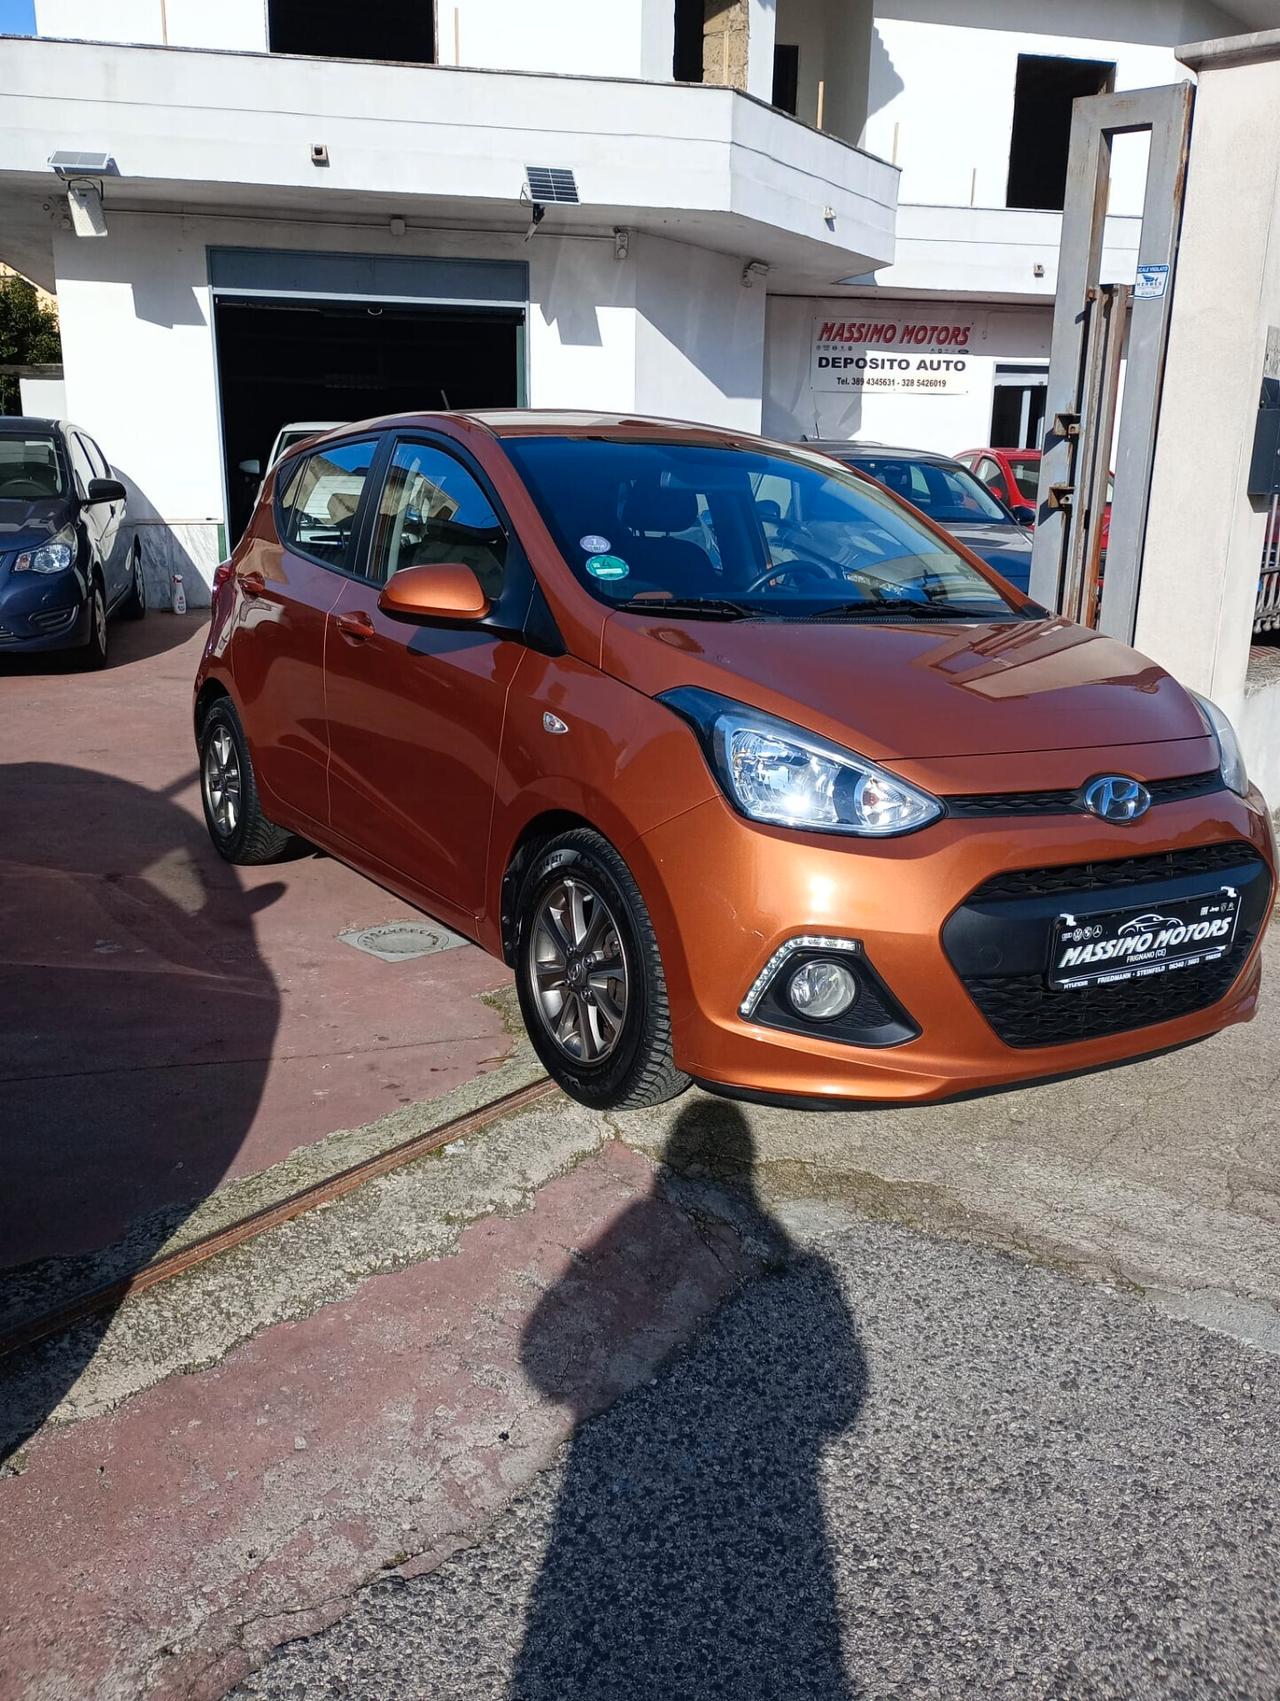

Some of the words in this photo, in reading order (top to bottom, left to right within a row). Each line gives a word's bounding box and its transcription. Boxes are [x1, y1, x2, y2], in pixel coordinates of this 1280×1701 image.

[817, 322, 897, 344] MASSIMO
[899, 325, 971, 346] MOTORS
[818, 356, 910, 370] DEPOSITO
[916, 359, 966, 372] AUTO
[836, 377, 850, 385] Tel.
[851, 377, 864, 386] 389
[866, 378, 895, 387] 4345631
[902, 379, 915, 387] 328
[917, 379, 946, 388] 5426019
[1058, 933, 1151, 968] MASSIMO
[1152, 917, 1232, 949] MOTORS
